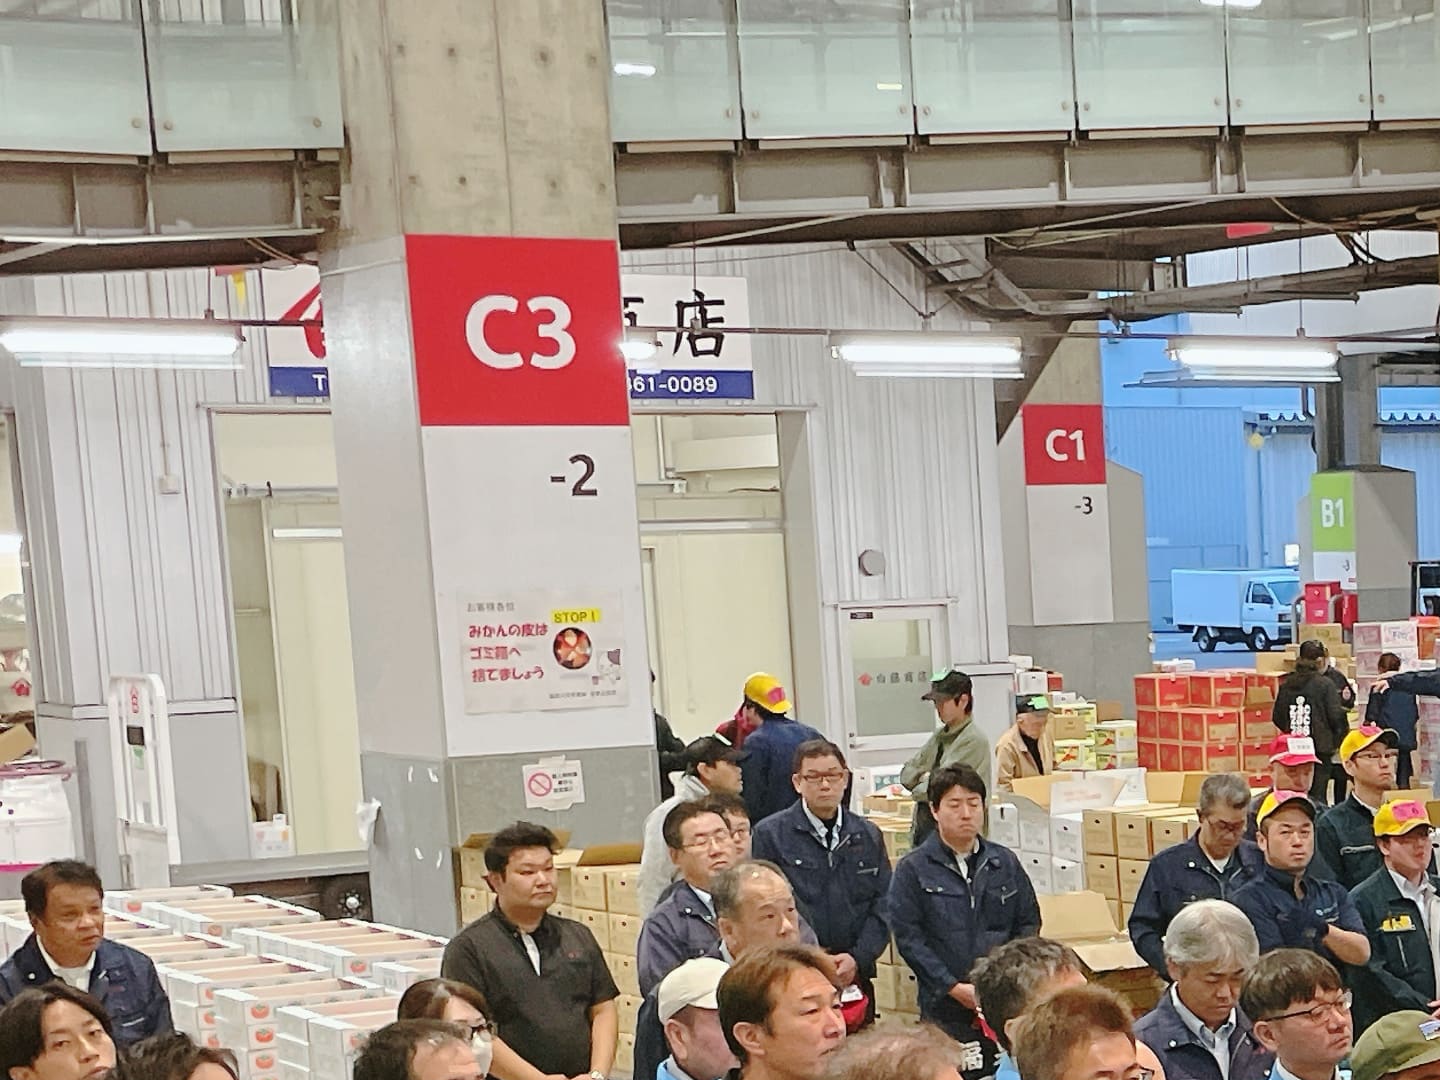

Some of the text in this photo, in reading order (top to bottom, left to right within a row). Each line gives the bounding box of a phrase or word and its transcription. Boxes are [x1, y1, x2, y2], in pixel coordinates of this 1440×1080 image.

[465, 294, 577, 369] C3
[1045, 429, 1085, 461] C1
[550, 454, 599, 496] -2
[1074, 496, 1093, 515] -3
[1321, 498, 1345, 528] B1
[468, 623, 549, 638] みかんの皮は
[469, 645, 522, 660] ゴミ箱へ
[471, 665, 545, 683] 捨てましょう
